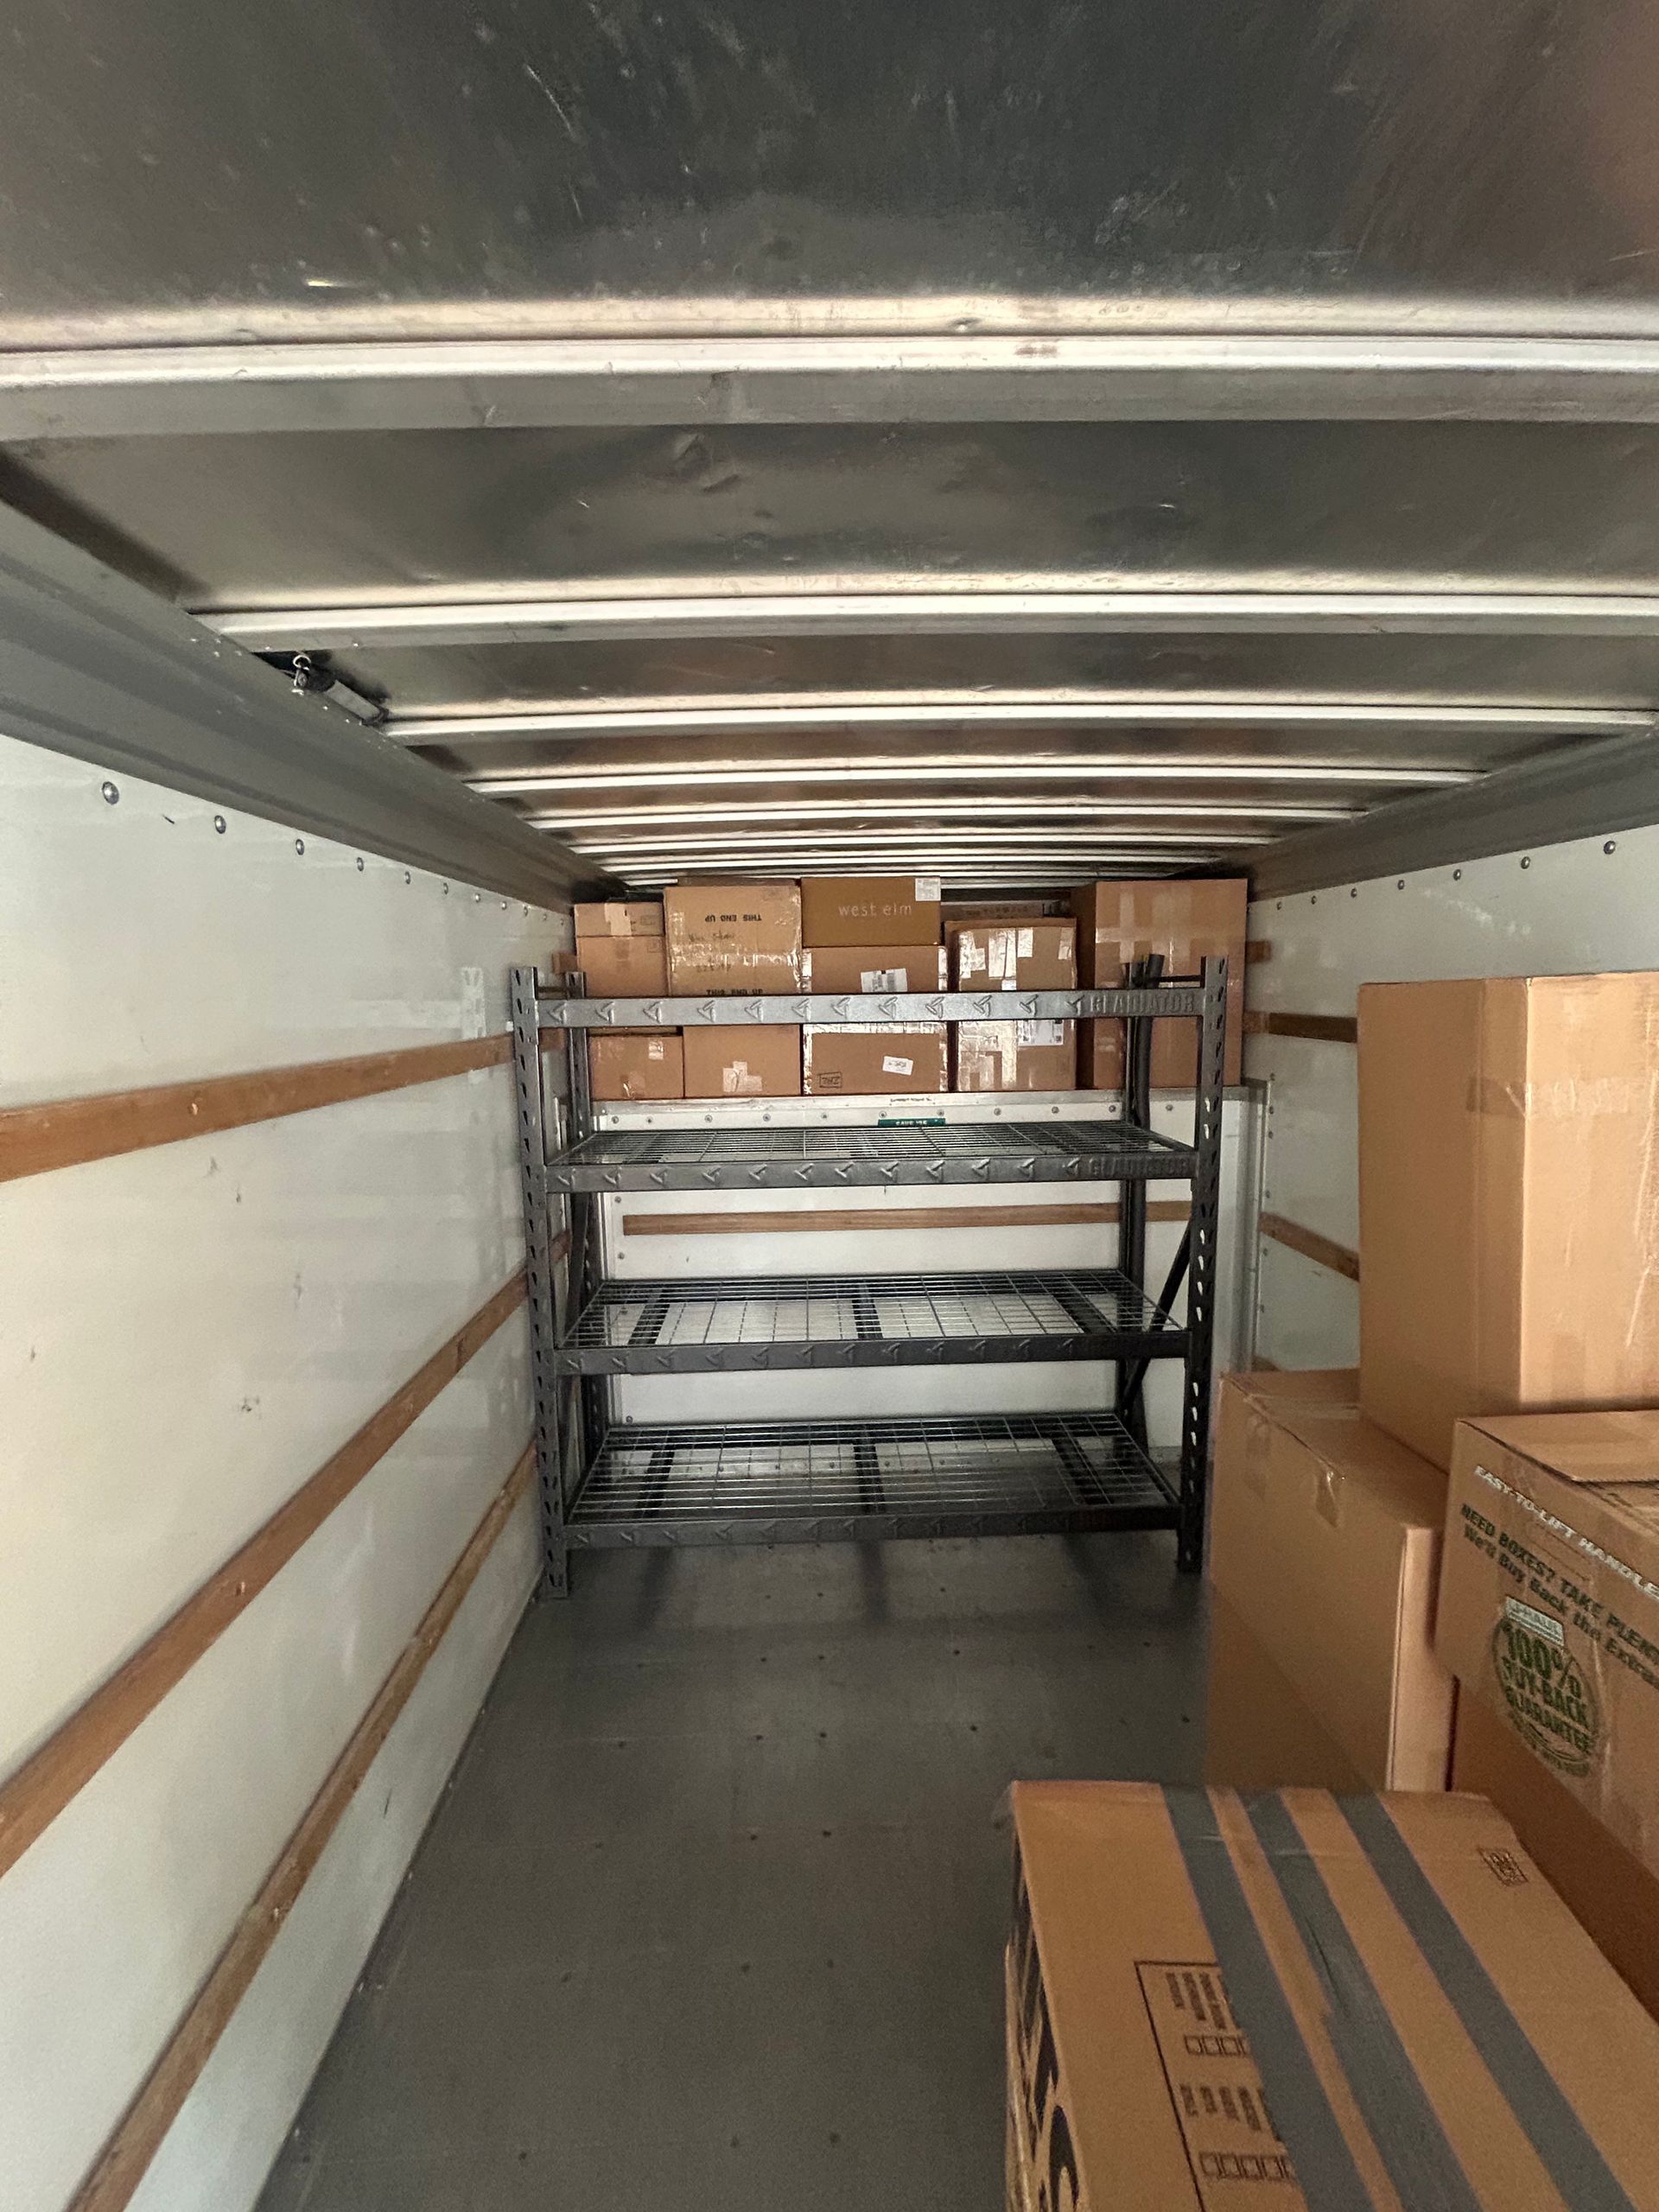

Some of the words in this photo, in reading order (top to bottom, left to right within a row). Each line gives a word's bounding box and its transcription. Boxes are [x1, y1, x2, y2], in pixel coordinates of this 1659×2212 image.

[704, 914, 716, 923] UP
[720, 914, 738, 923] END
[742, 913, 762, 922] THIS
[838, 902, 877, 917] west
[882, 902, 912, 916] elm
[1474, 1465, 1577, 1539] EASY-TO-LIFT
[1461, 1503, 1496, 1537] NEED
[1498, 1530, 1555, 1582] BOXES?
[1560, 1576, 1604, 1618] TAKE
[1498, 1552, 1526, 1585] Buy
[1529, 1575, 1568, 1616] Back
[1573, 1610, 1600, 1641] the
[1500, 1618, 1582, 1699] 100%
[1501, 1655, 1588, 1729] BUY-BACK
